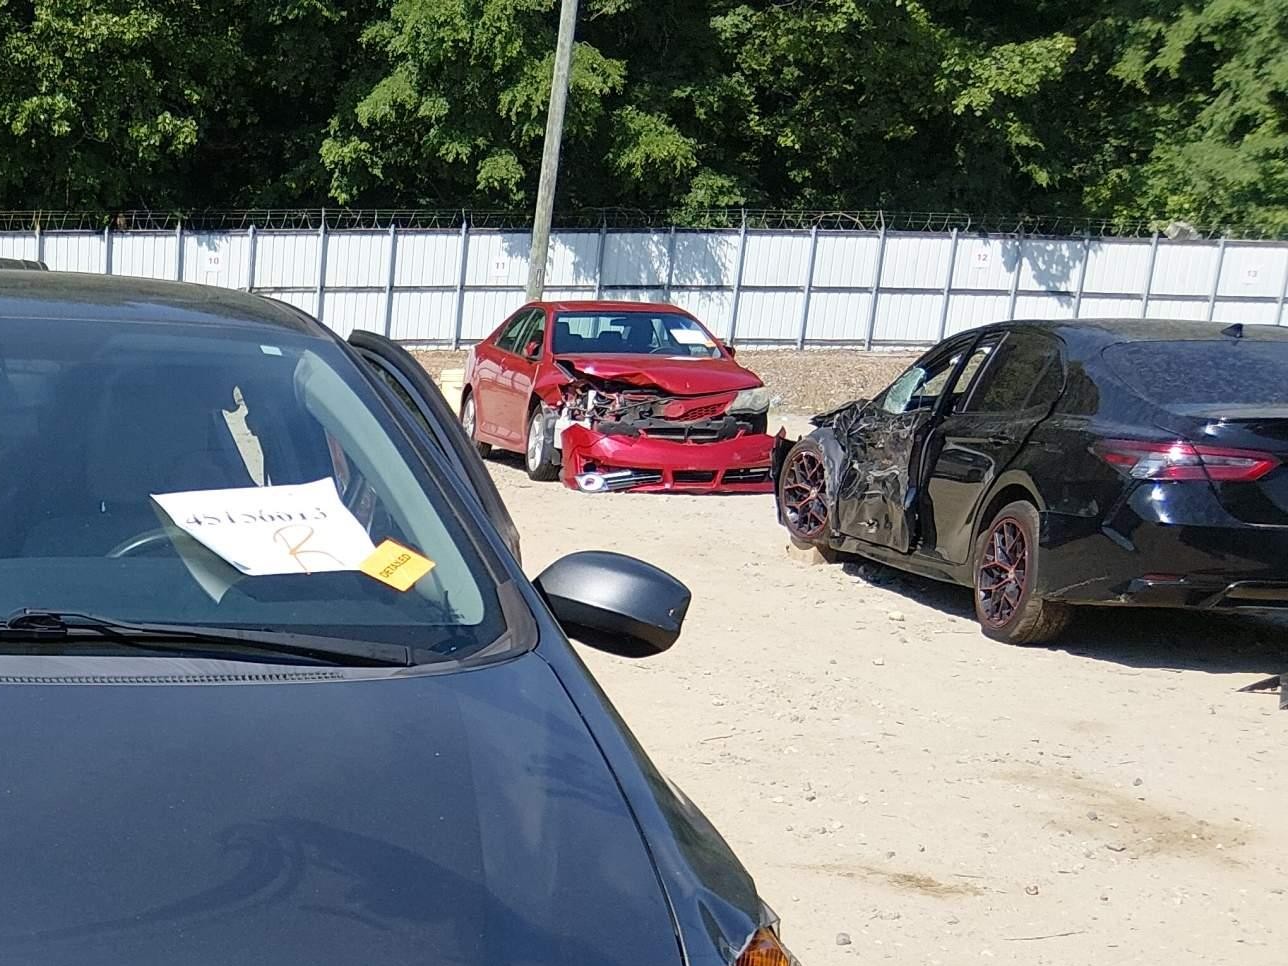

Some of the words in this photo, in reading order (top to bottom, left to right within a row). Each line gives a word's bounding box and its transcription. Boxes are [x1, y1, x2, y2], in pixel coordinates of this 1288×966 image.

[208, 257, 219, 265] 10
[977, 254, 988, 262] 12
[495, 262, 505, 270] 11
